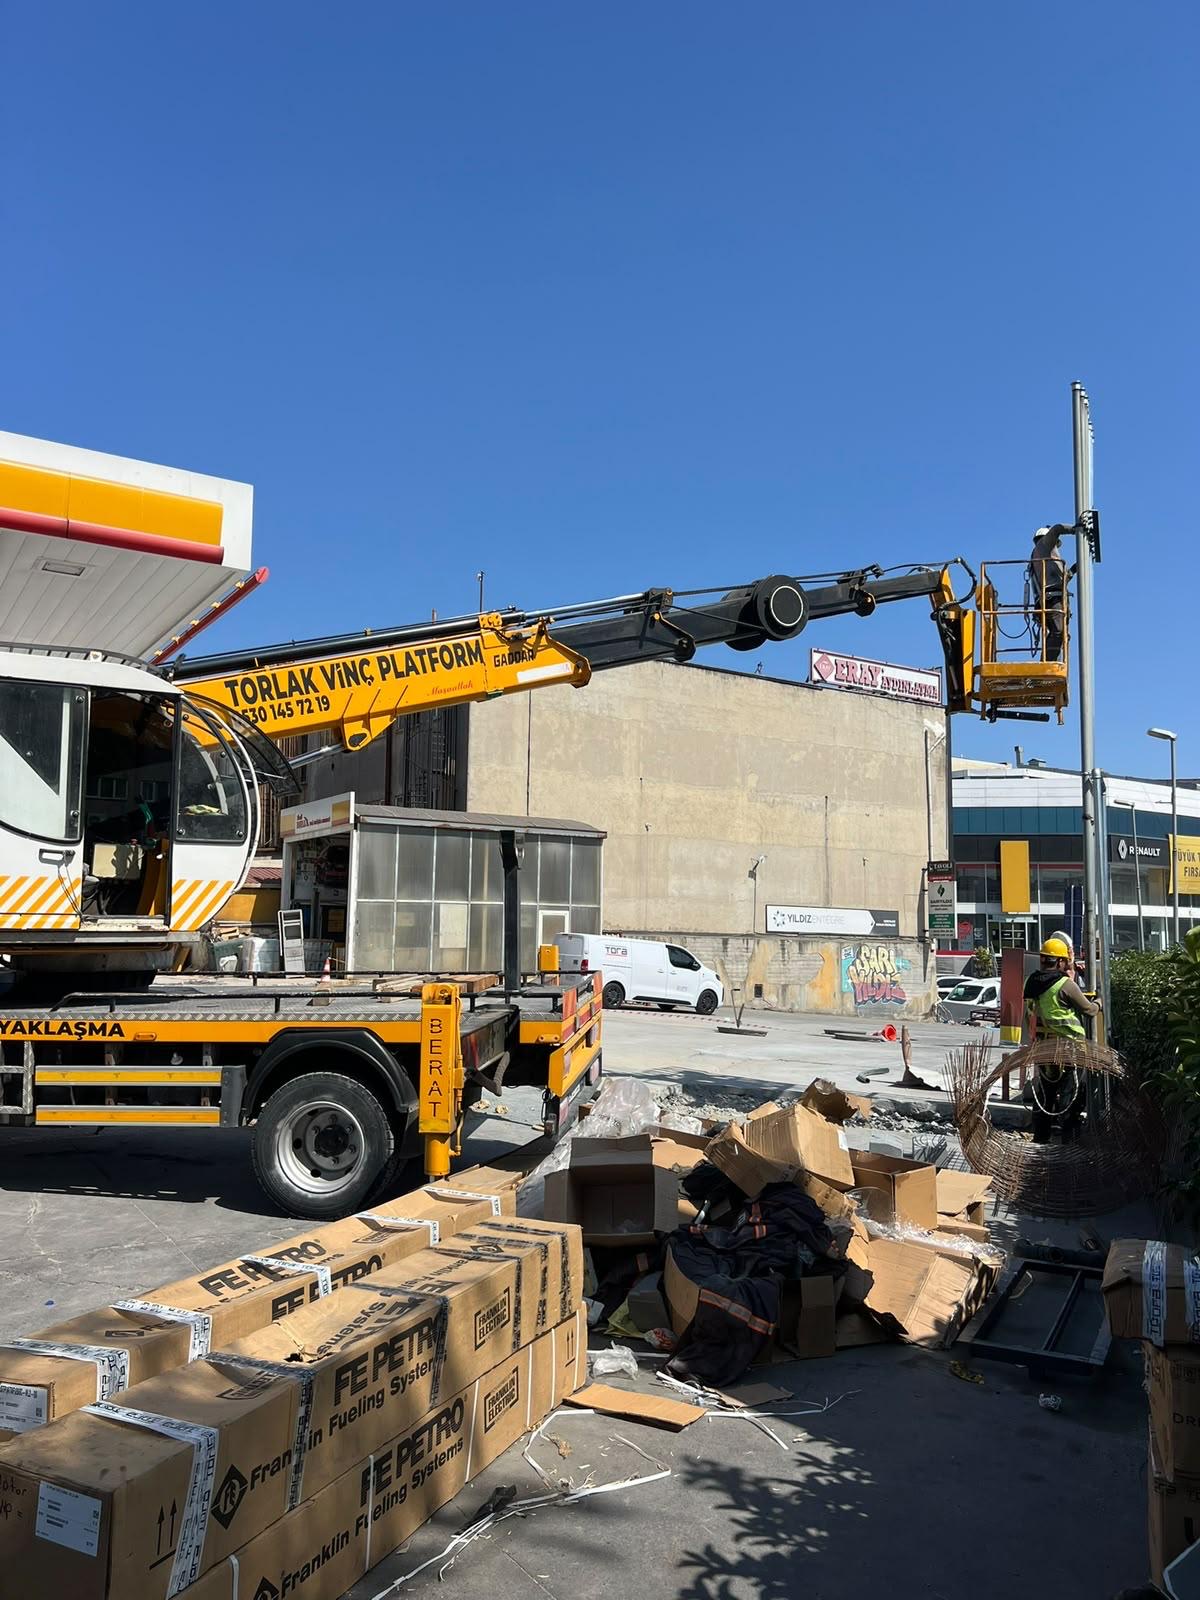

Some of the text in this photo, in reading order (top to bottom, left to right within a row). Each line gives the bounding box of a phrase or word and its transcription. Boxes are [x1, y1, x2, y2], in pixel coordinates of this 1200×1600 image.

[224, 667, 319, 707] TORLAK
[377, 640, 485, 681] PLATFORM
[494, 650, 535, 668] GADDAR
[835, 659, 938, 699] ERAY AYDINLATMA
[269, 702, 294, 720] 145
[296, 698, 314, 716] 72
[315, 695, 330, 712] 19
[1129, 846, 1160, 857] RENAULT
[1177, 849, 1196, 862] ÜYÜK
[1184, 867, 1200, 878] FIRS
[787, 914, 812, 923] YILDIZ
[856, 944, 898, 976] SARI
[0, 1021, 125, 1040] YAKLAŞMA
[428, 1018, 443, 1117] BERAT
[198, 1268, 250, 1297] FE
[478, 1298, 507, 1325] FRANKLIN
[478, 1310, 507, 1340] ELECTRIC
[317, 1301, 387, 1355] Systems
[334, 1352, 369, 1406] FE
[488, 1377, 515, 1410] FRANKLIN
[250, 1427, 323, 1491] Franin
[329, 1389, 385, 1437] Fueling
[390, 1349, 447, 1396] Syste
[488, 1388, 515, 1422] ELECTRIC
[360, 1450, 393, 1507] FE
[396, 1397, 464, 1479] PETRO
[281, 1530, 349, 1599] Franklin
[355, 1483, 408, 1537] Fueling
[412, 1438, 464, 1489] Systems
